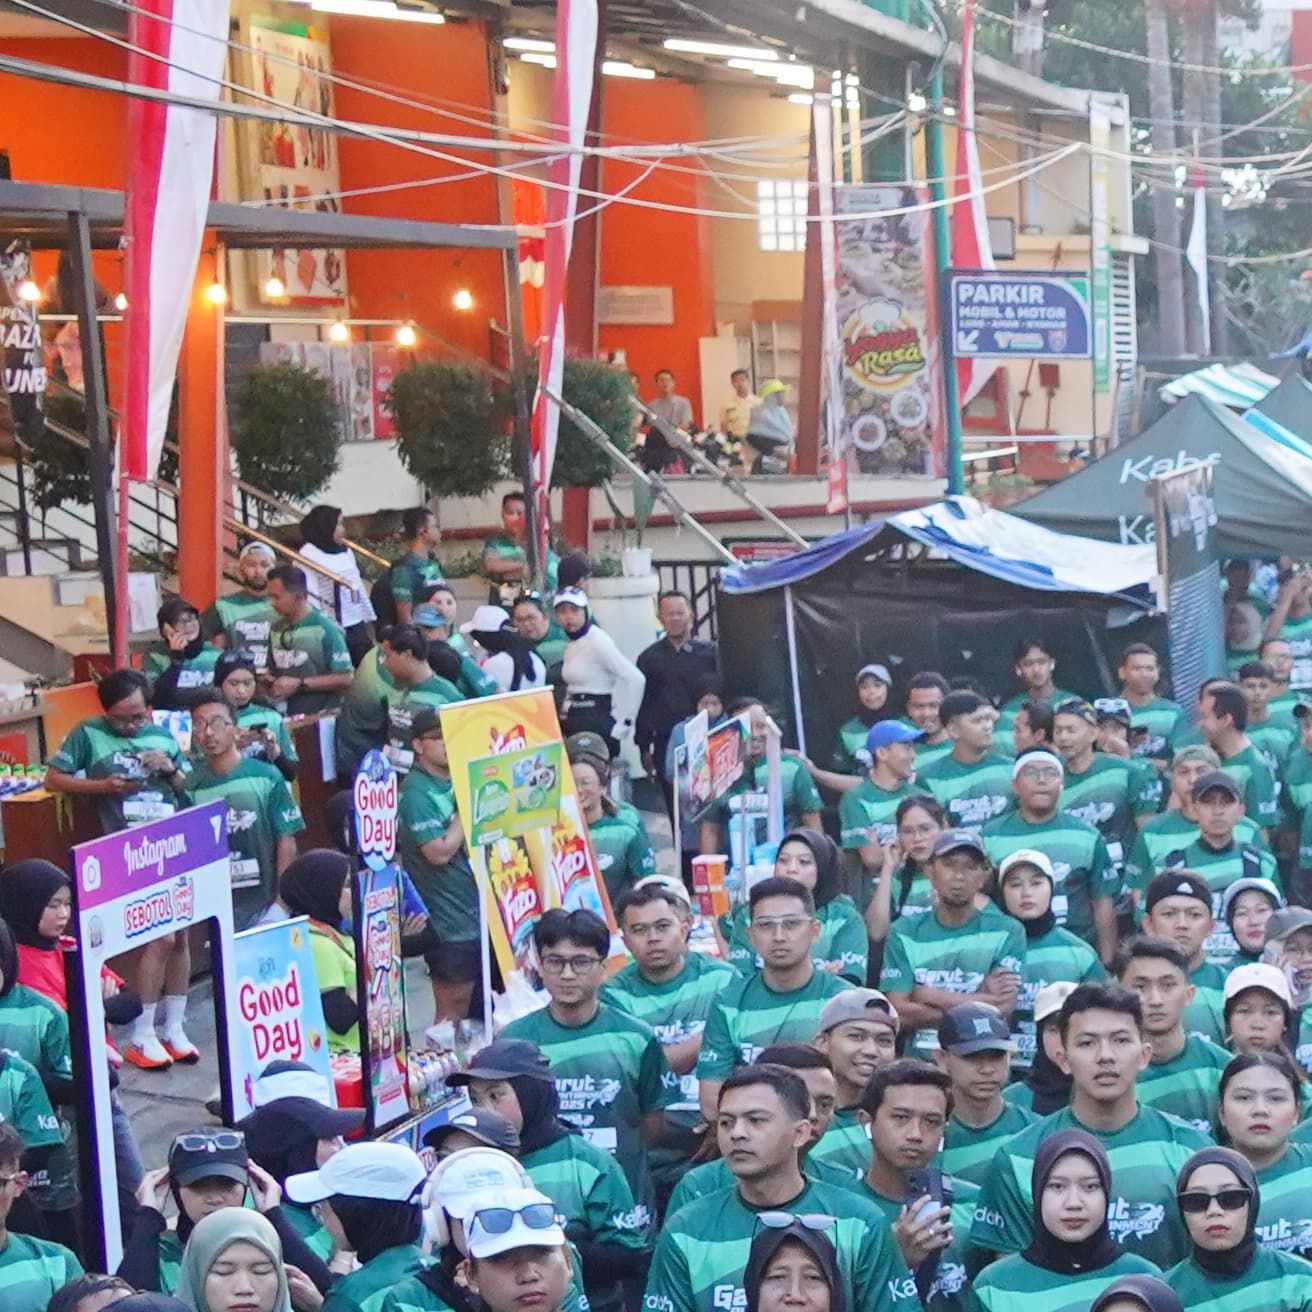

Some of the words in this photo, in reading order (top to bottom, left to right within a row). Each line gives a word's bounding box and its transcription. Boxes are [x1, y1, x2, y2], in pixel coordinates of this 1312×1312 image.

[958, 283, 1045, 304] PARKIR
[1004, 307, 1015, 320] &
[1017, 306, 1067, 320] MOTOR
[357, 777, 396, 812] Good
[362, 812, 394, 851] Day
[124, 833, 188, 876] Instagram
[914, 966, 963, 984] Garut
[239, 969, 300, 1022] Good
[252, 1017, 303, 1064] Day
